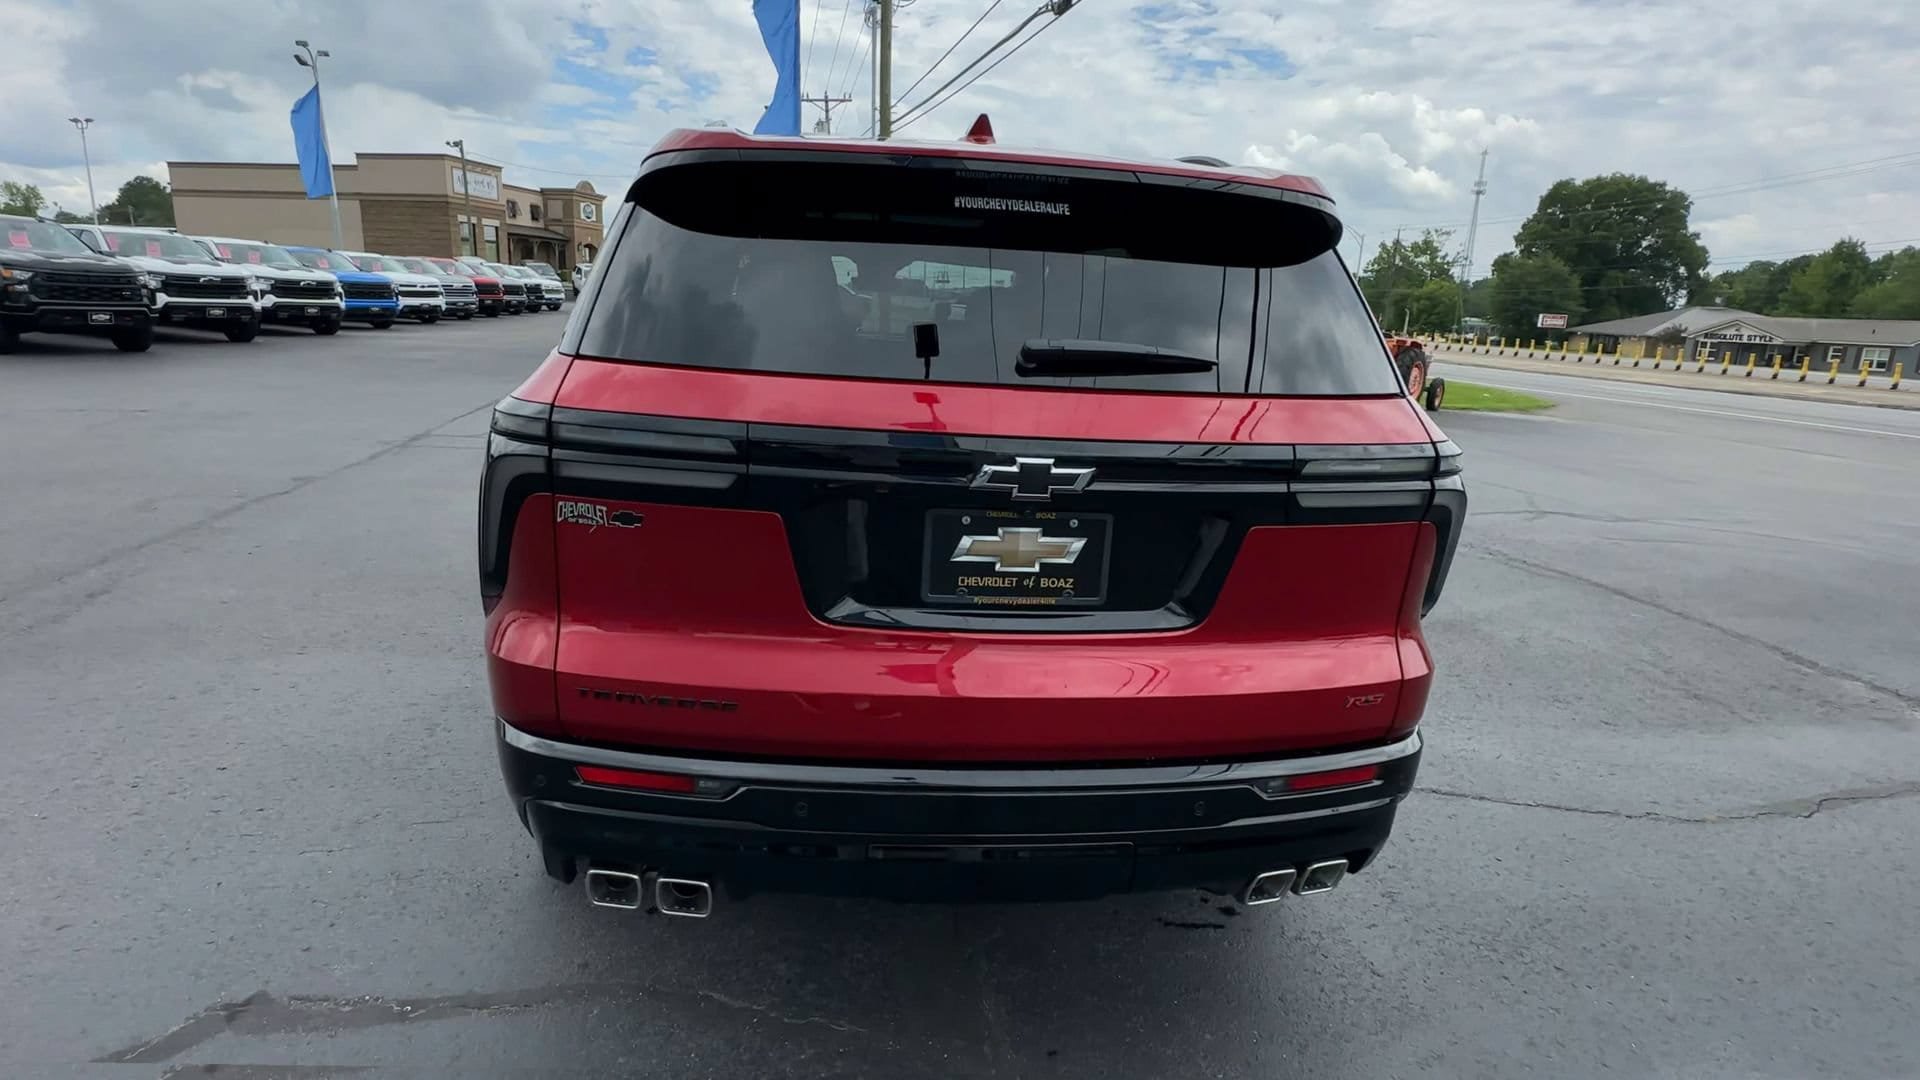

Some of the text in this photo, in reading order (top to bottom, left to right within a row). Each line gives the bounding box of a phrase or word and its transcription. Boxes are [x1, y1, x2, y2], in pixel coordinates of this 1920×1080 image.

[954, 196, 1071, 216] #YOURCHEVYDEALER4LIFE
[1746, 334, 1775, 343] STYLE
[557, 501, 608, 527] CHEVROLET
[958, 575, 1074, 589] CHEVROLET of BOAZ
[576, 687, 739, 713] TRAVERSE
[1344, 693, 1384, 709] RS
